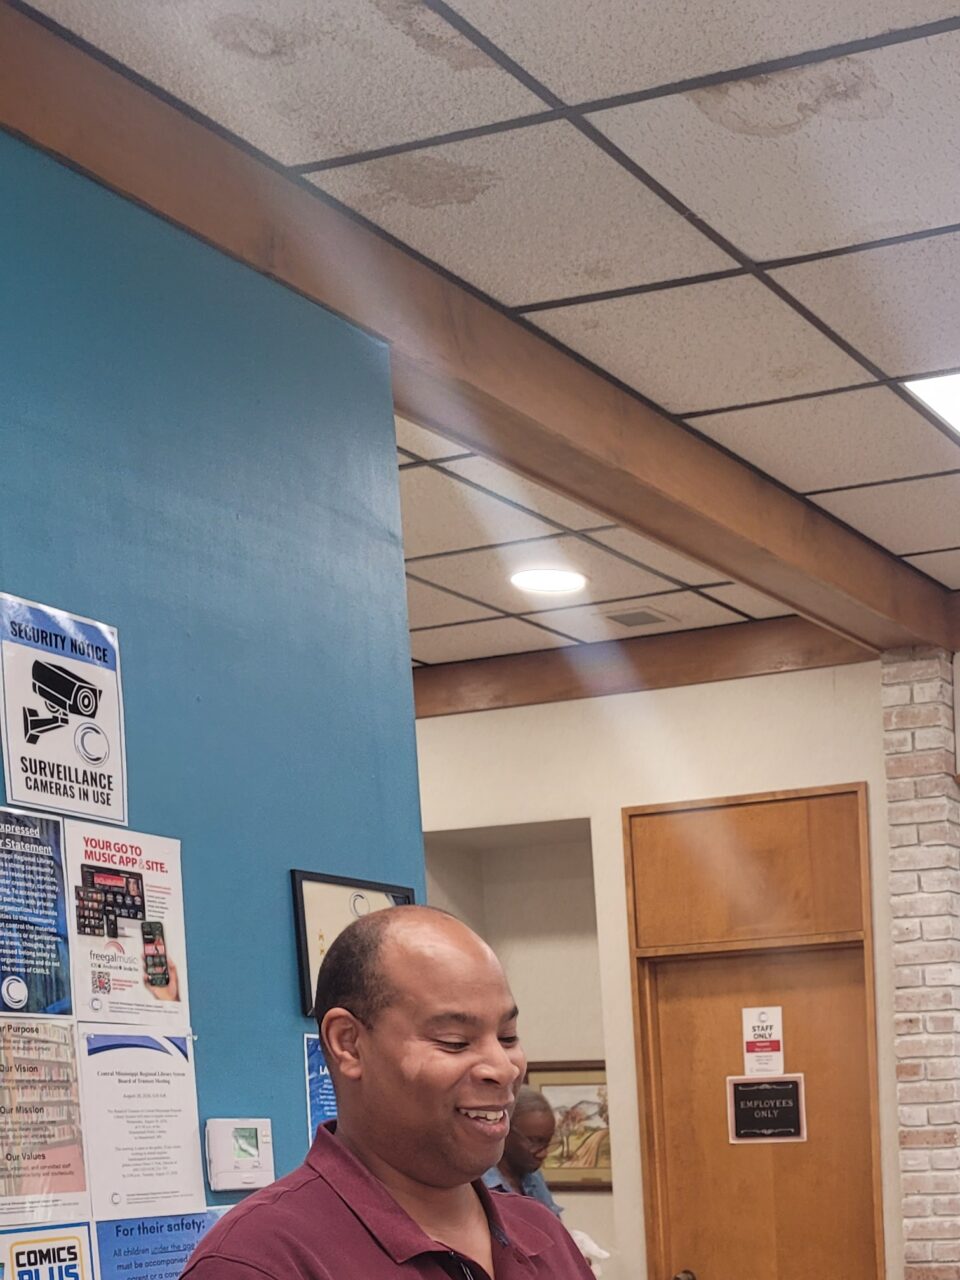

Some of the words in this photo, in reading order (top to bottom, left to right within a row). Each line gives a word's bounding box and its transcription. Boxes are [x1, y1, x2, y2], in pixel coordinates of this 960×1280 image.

[10, 620, 66, 651] SECURITY
[70, 639, 108, 663] NOTICE
[20, 756, 114, 792] SURVEILLANCE
[25, 776, 75, 799] CAMERAS
[78, 787, 89, 802] IN
[92, 790, 112, 807] USE
[6, 838, 52, 855] Statement
[83, 836, 111, 852] YOUR
[113, 842, 128, 854] GO
[129, 845, 142, 857] TO
[84, 849, 117, 864] MUSIC
[118, 855, 137, 868] APP
[145, 860, 168, 873] SITE.
[7, 1024, 40, 1035] Purpose
[752, 1024, 773, 1033] STAFF
[753, 1032, 772, 1040] ONLY
[15, 1064, 39, 1073] Vision
[0, 1105, 13, 1114] Our
[16, 1105, 44, 1114] Mission
[739, 1098, 794, 1109] EMPLOYEES
[754, 1109, 779, 1119] ONLY
[5, 1152, 20, 1161] Our
[21, 1152, 46, 1160] Values
[115, 1224, 134, 1238] For
[137, 1221, 165, 1235] their
[167, 1217, 206, 1234] safety:
[15, 1245, 78, 1268] COMICS
[113, 1247, 122, 1257] All
[123, 1246, 149, 1257] children
[116, 1261, 133, 1271] must
[134, 1260, 143, 1269] be
[144, 1254, 189, 1268] accompanied
